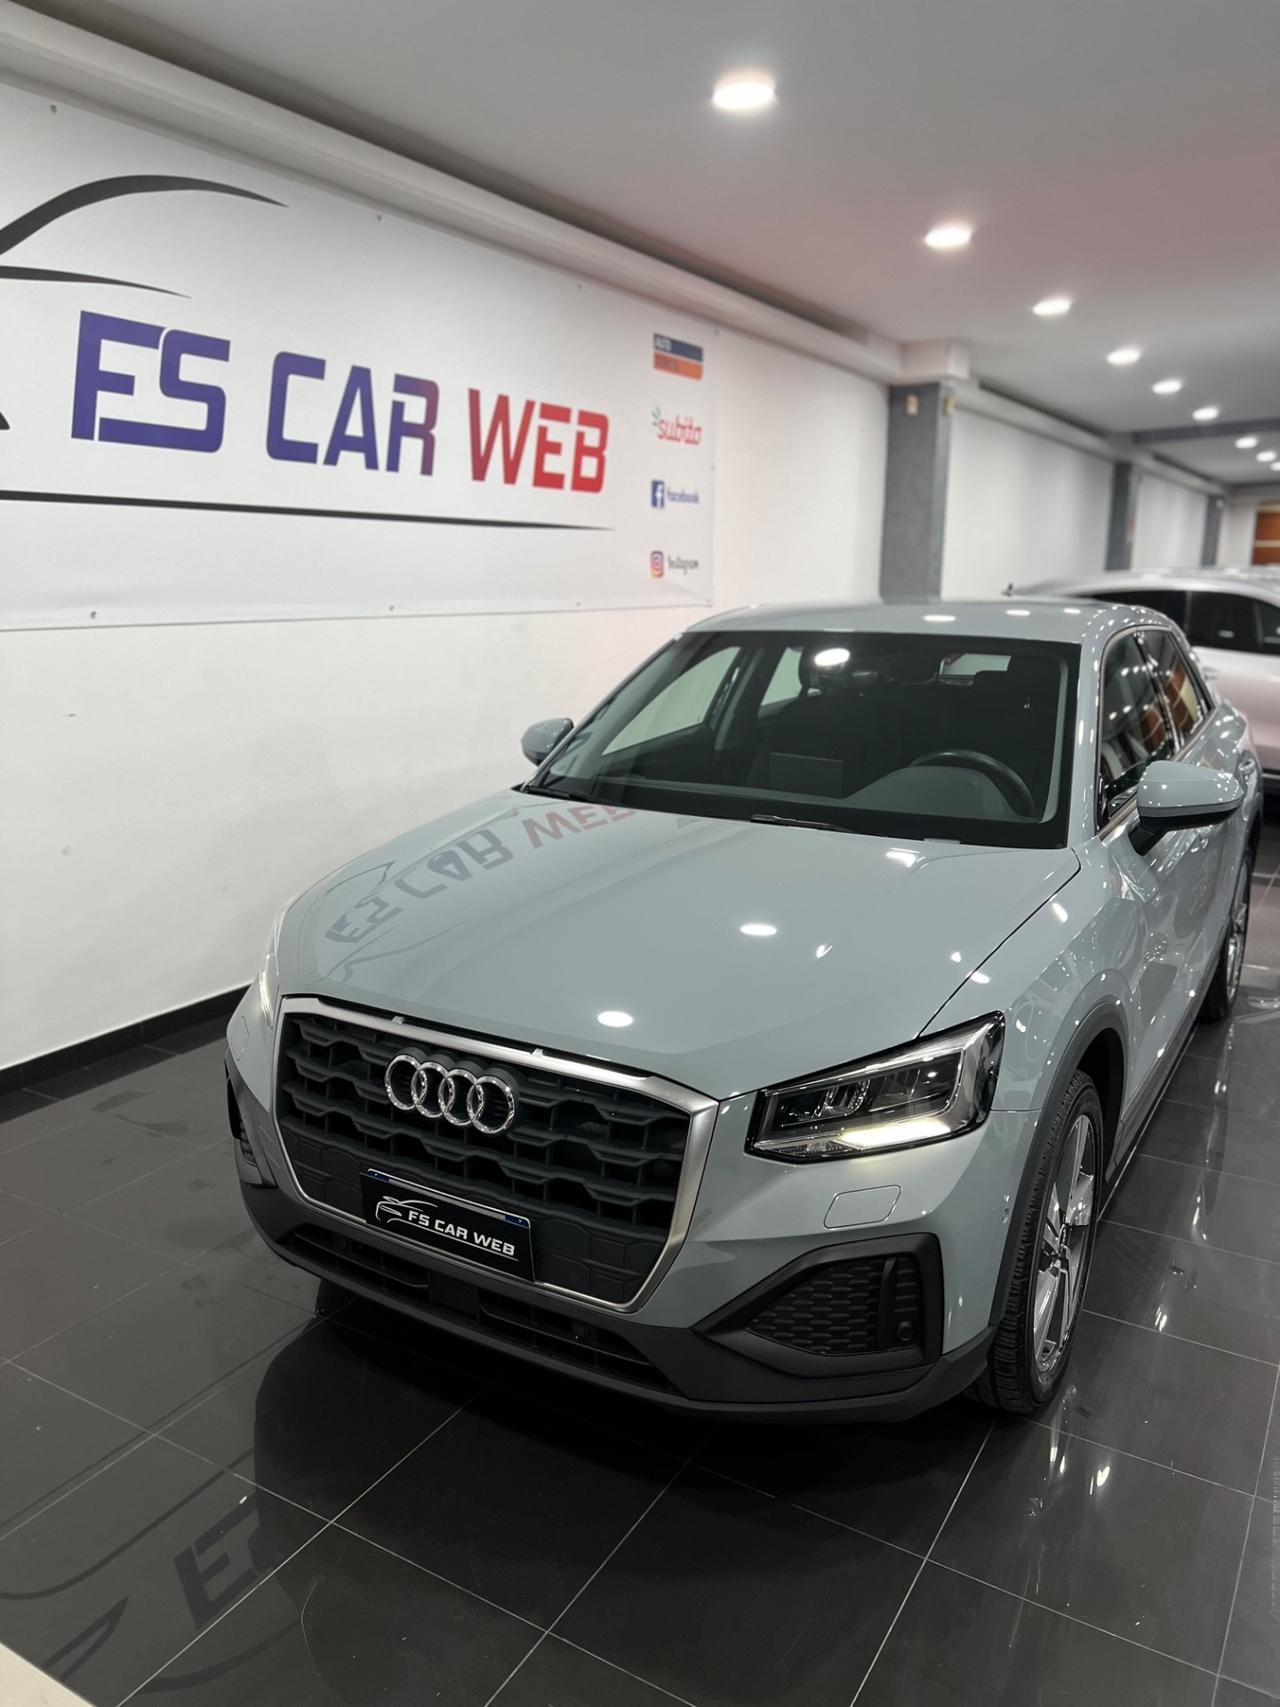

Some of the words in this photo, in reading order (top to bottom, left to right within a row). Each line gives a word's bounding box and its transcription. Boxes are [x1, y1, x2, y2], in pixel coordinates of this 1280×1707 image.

[266, 351, 440, 476] CAR
[468, 388, 609, 493] WEB
[408, 1210, 430, 1227] FS
[434, 1220, 468, 1240] CAR
[473, 1232, 515, 1256] WEB
